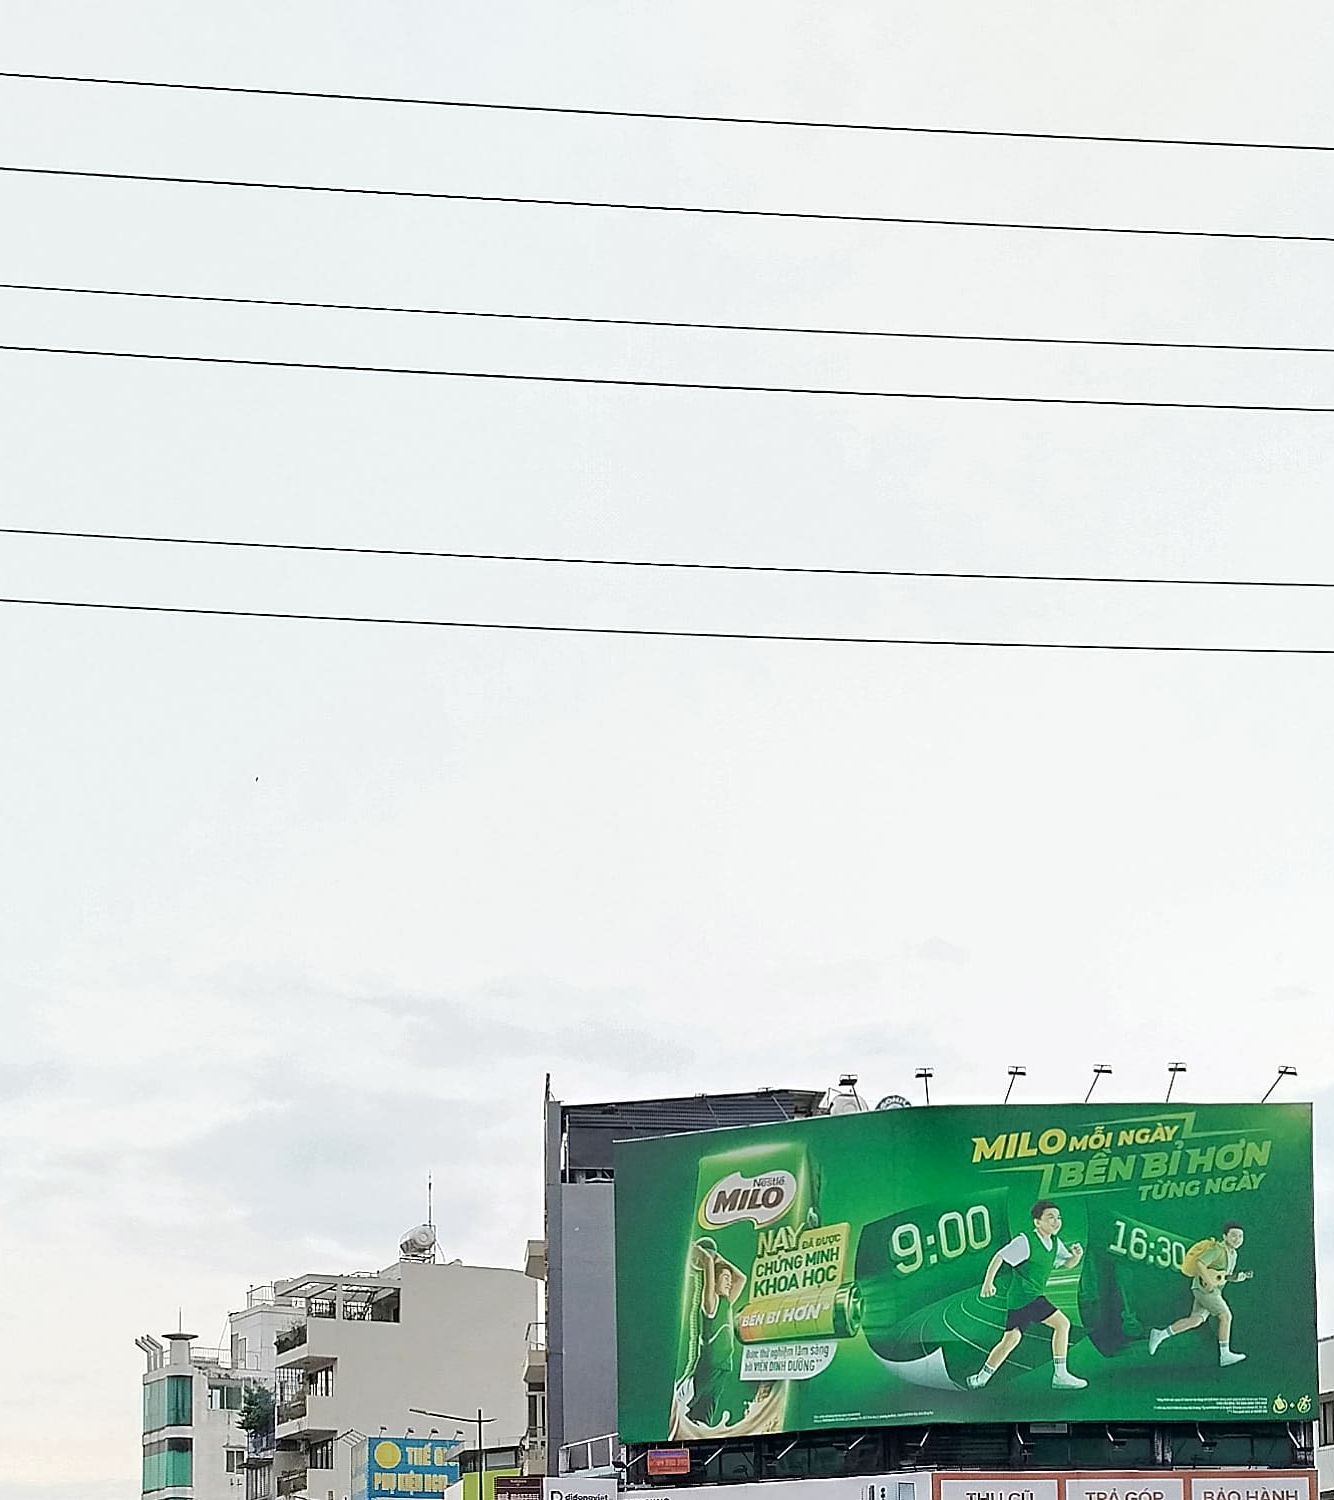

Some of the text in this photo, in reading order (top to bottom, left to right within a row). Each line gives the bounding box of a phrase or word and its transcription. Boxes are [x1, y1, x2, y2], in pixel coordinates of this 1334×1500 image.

[972, 1123, 1178, 1163] MILO MỖI NGÀY
[1058, 1139, 1272, 1187] BỀN BỈ HƠN
[713, 1187, 785, 1214] MILO
[1138, 1172, 1266, 1201] TỪNG NGÀY
[757, 1223, 806, 1258] NAY
[891, 1205, 992, 1273] 9:00
[1109, 1220, 1186, 1270] 16:30
[755, 1247, 839, 1278] CHỨNG MINH
[754, 1265, 838, 1297] KHOA HỌC
